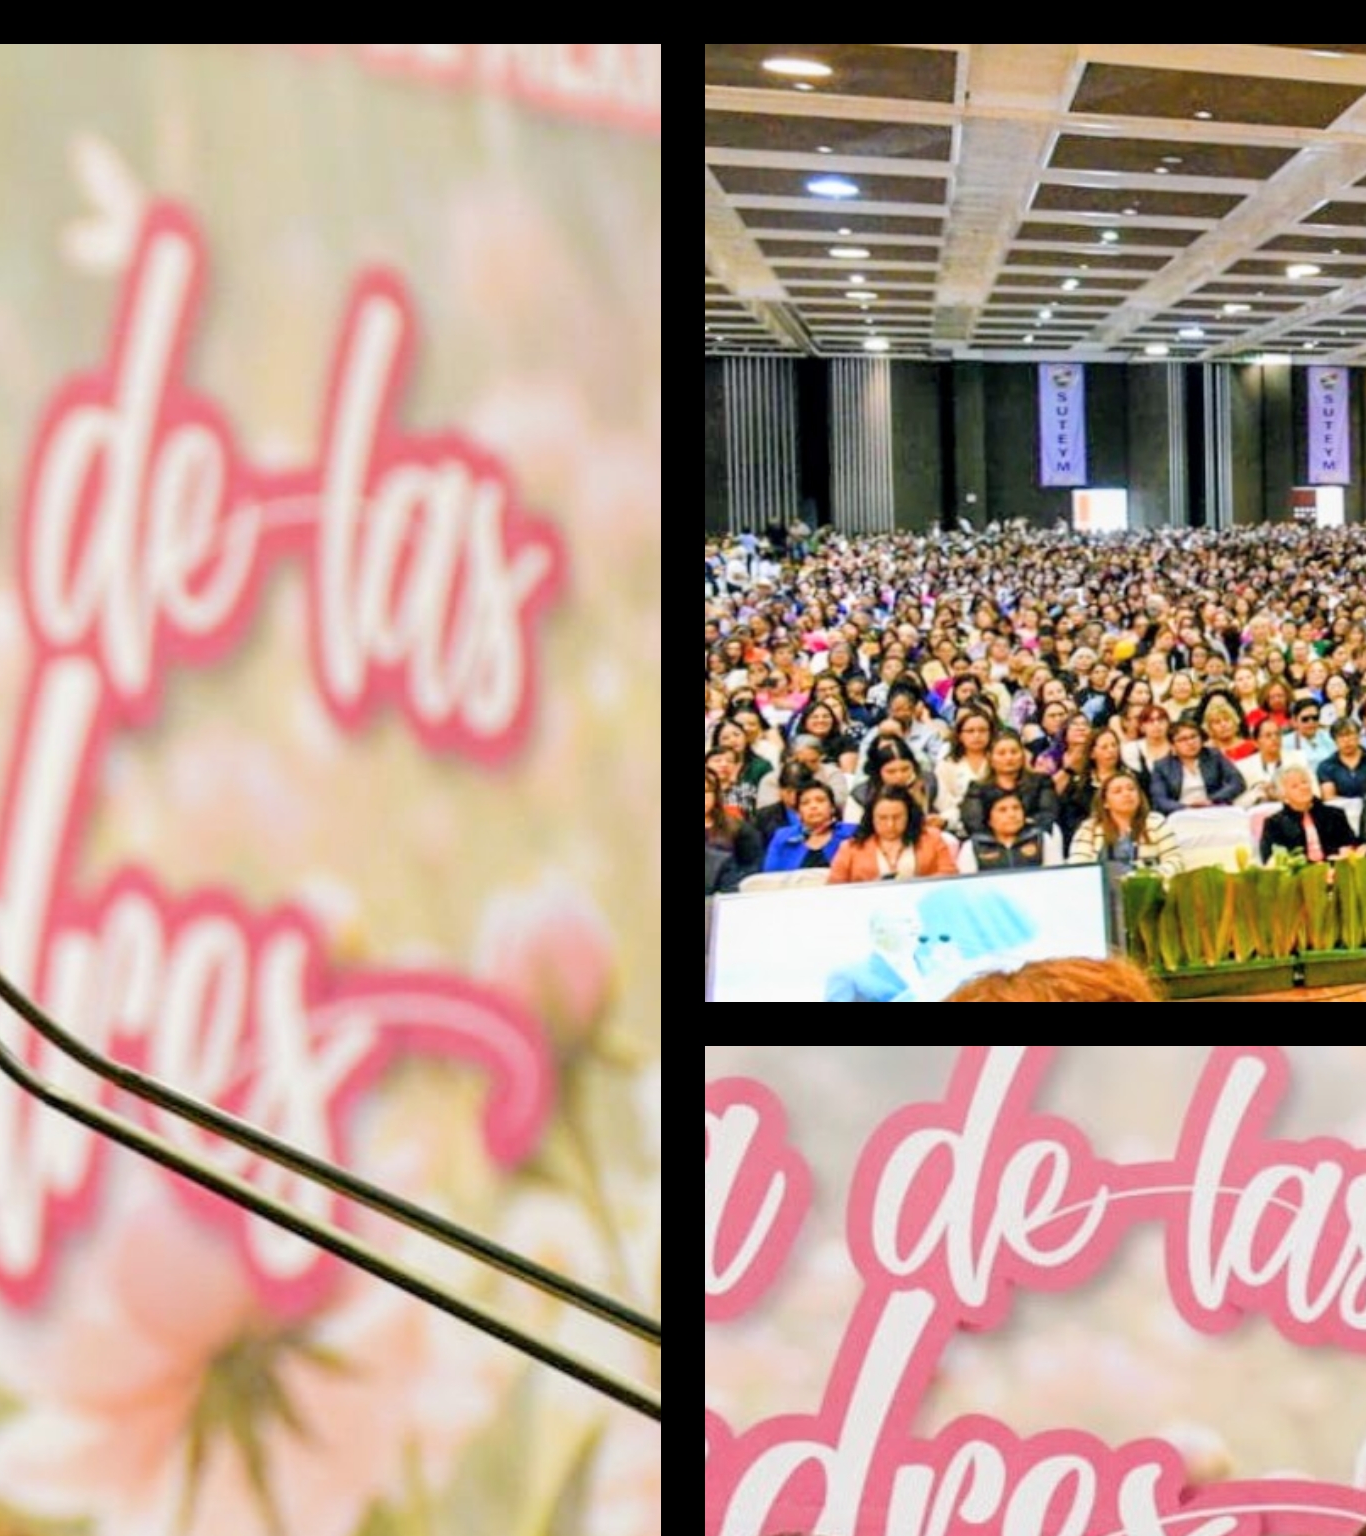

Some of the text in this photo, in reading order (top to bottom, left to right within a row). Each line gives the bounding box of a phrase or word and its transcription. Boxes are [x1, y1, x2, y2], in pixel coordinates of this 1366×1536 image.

[37, 231, 263, 697] de
[319, 293, 551, 735] las
[1056, 391, 1071, 473] SUTEYM
[1322, 393, 1336, 472] SUTEYM
[872, 1047, 1109, 1307] de
